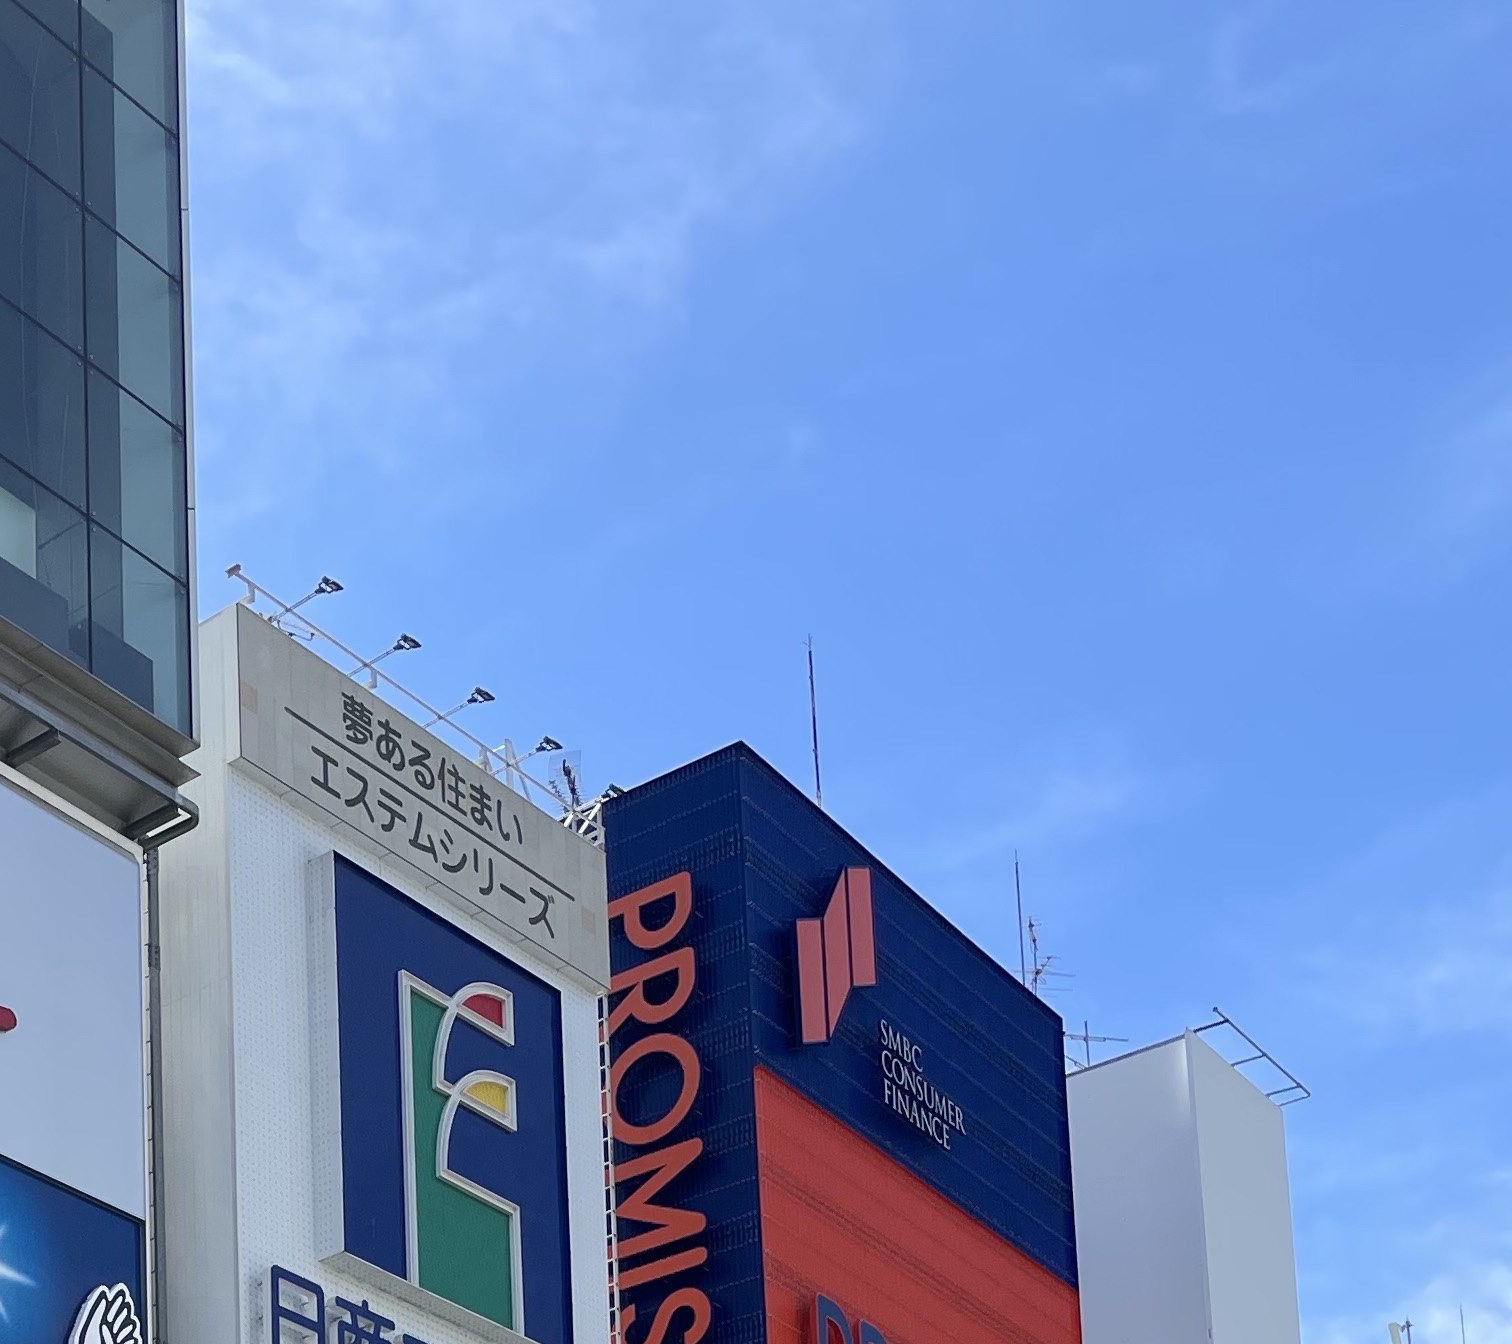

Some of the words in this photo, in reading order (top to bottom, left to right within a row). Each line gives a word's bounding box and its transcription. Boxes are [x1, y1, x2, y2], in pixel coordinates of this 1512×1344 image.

[342, 691, 524, 847] 夢ある住まい
[310, 746, 558, 940] エステムシリーズ
[879, 1018, 924, 1071] SMBC
[881, 1047, 967, 1137] CONSUMER
[883, 1080, 952, 1151] FINANCE
